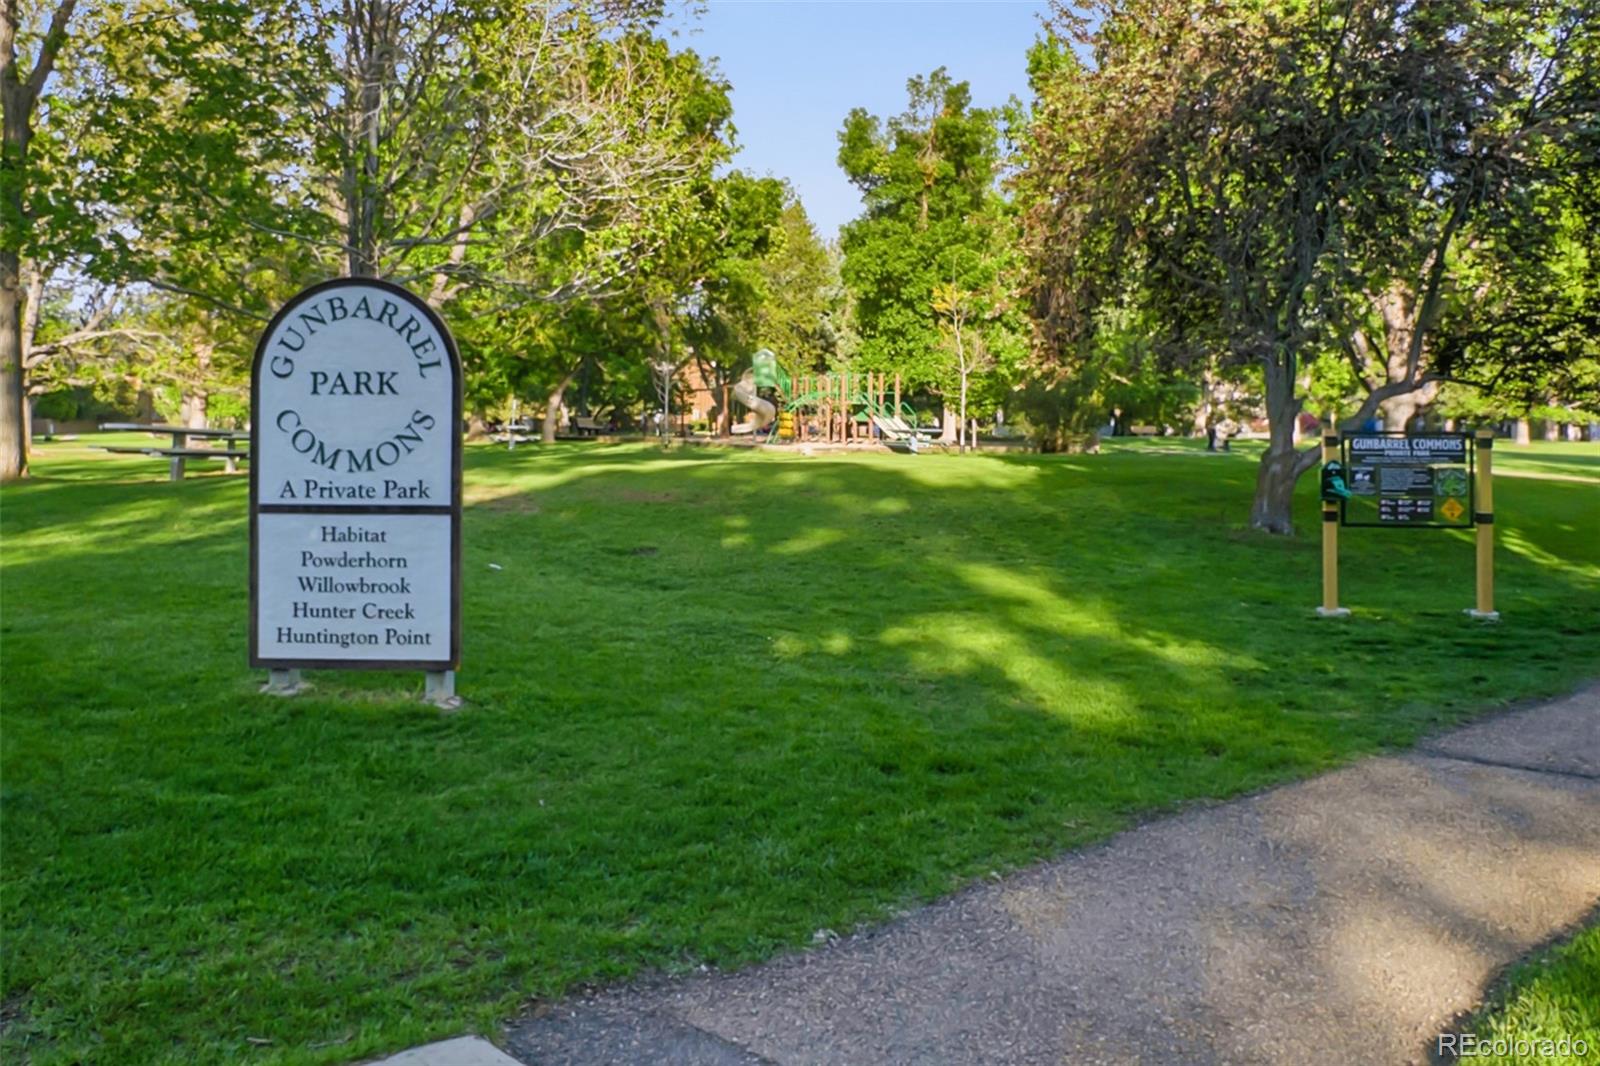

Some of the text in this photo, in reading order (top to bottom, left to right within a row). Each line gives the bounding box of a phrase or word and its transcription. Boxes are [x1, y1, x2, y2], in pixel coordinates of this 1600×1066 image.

[270, 295, 442, 380] GUNBARREL
[310, 371, 399, 396] PARK
[276, 409, 436, 473] COMMONS
[1352, 438, 1463, 450] GUNBARREL COMMONS
[279, 479, 431, 499] A Private Park
[321, 526, 387, 543] Habitat
[301, 551, 408, 569] Powderhorn
[297, 576, 411, 594] Willowbrook
[292, 602, 415, 620] Hunter Creek
[276, 627, 431, 648] Huntington Point
